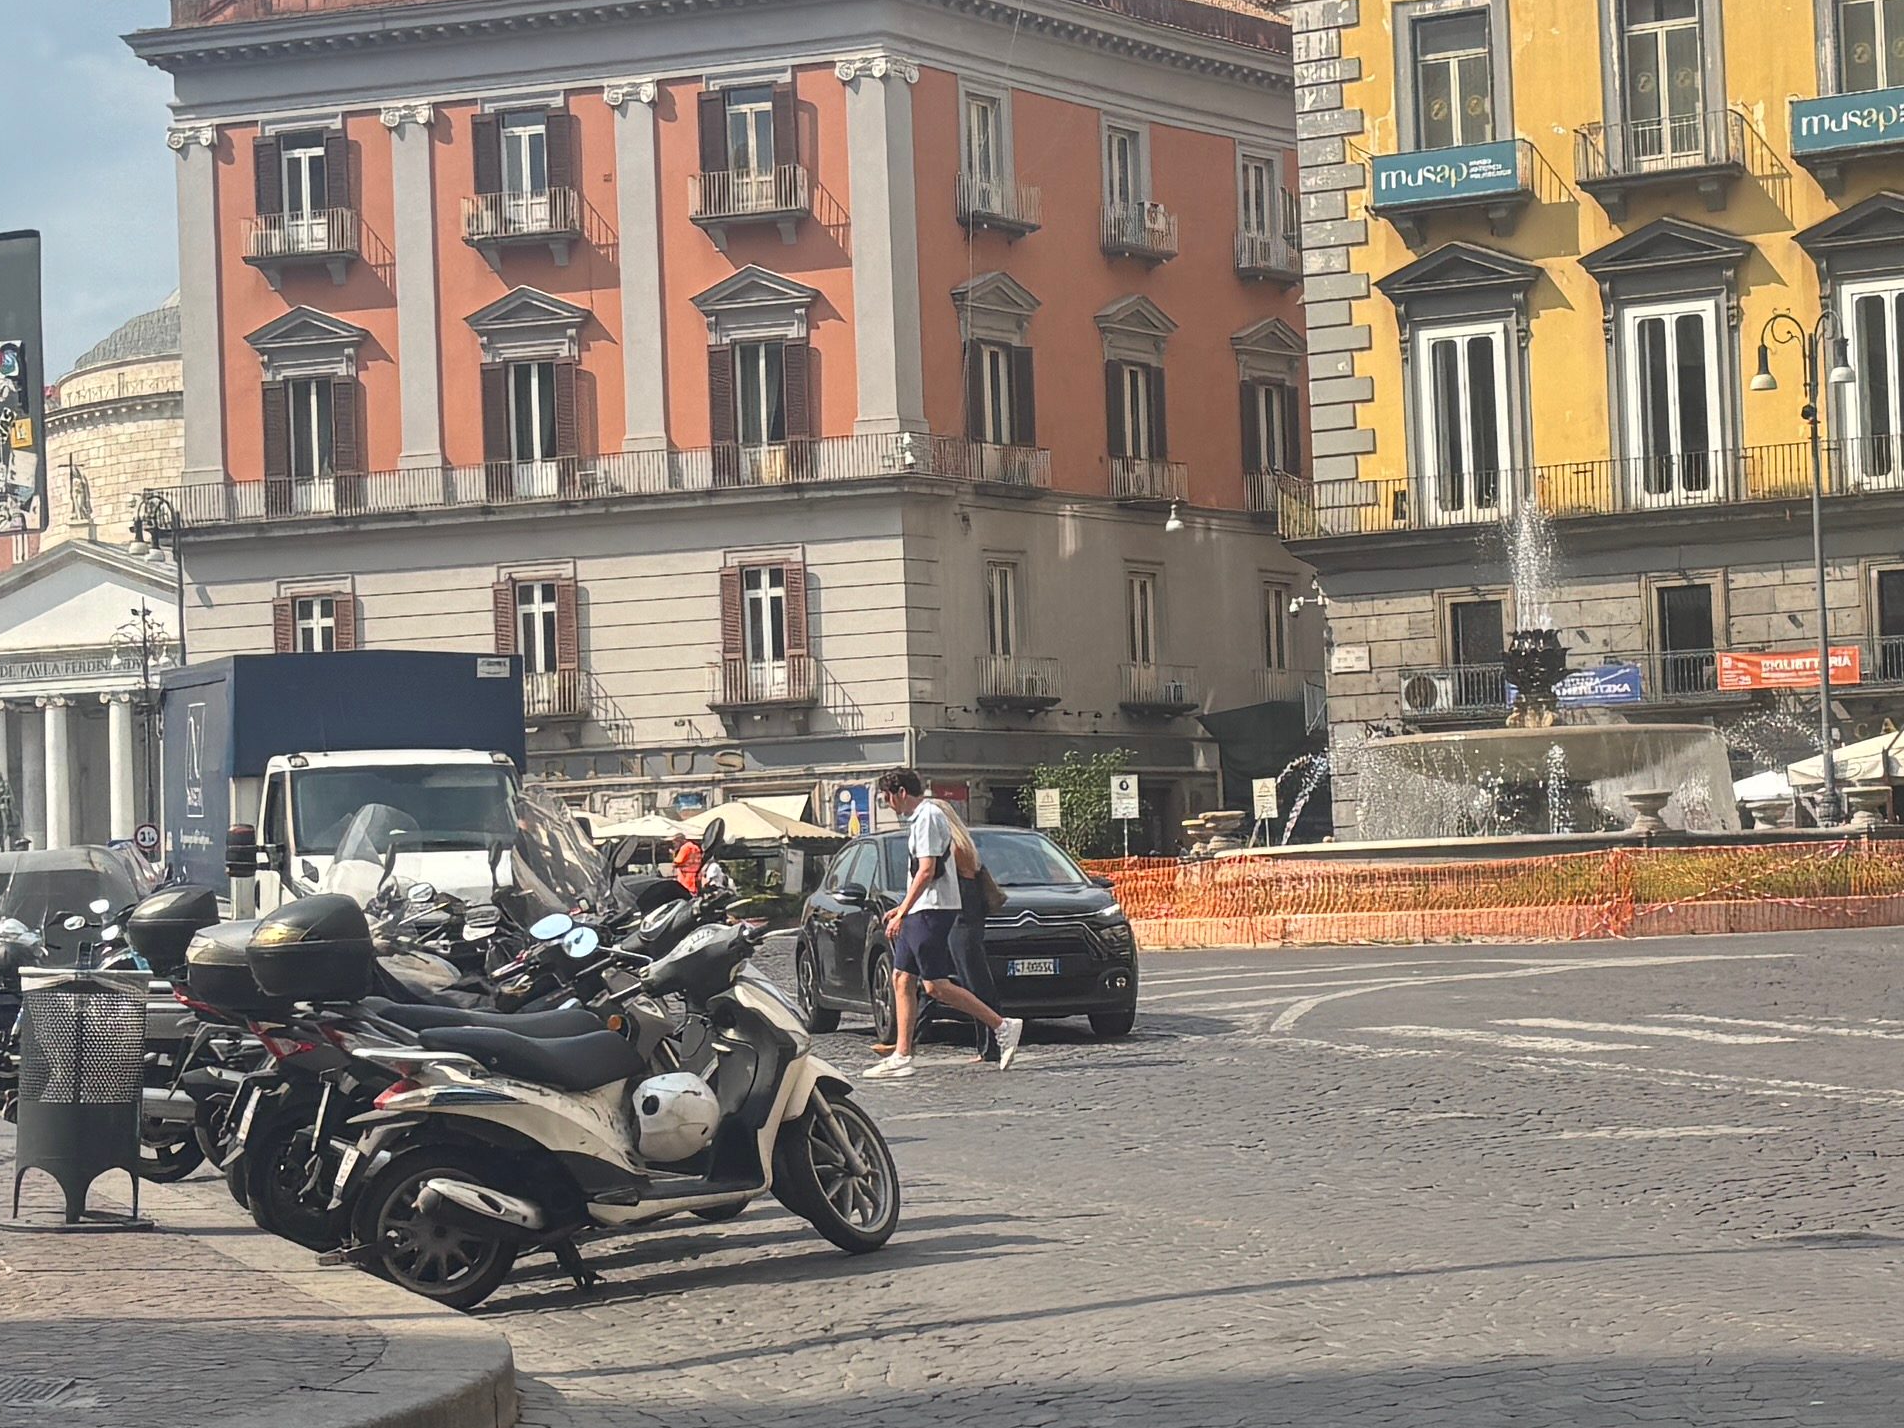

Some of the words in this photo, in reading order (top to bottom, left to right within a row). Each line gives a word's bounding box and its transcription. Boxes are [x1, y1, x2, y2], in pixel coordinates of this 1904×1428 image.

[1801, 105, 1897, 136] musap
[1381, 163, 1467, 190] musap
[1761, 655, 1851, 672] BIGLIETTRIA
